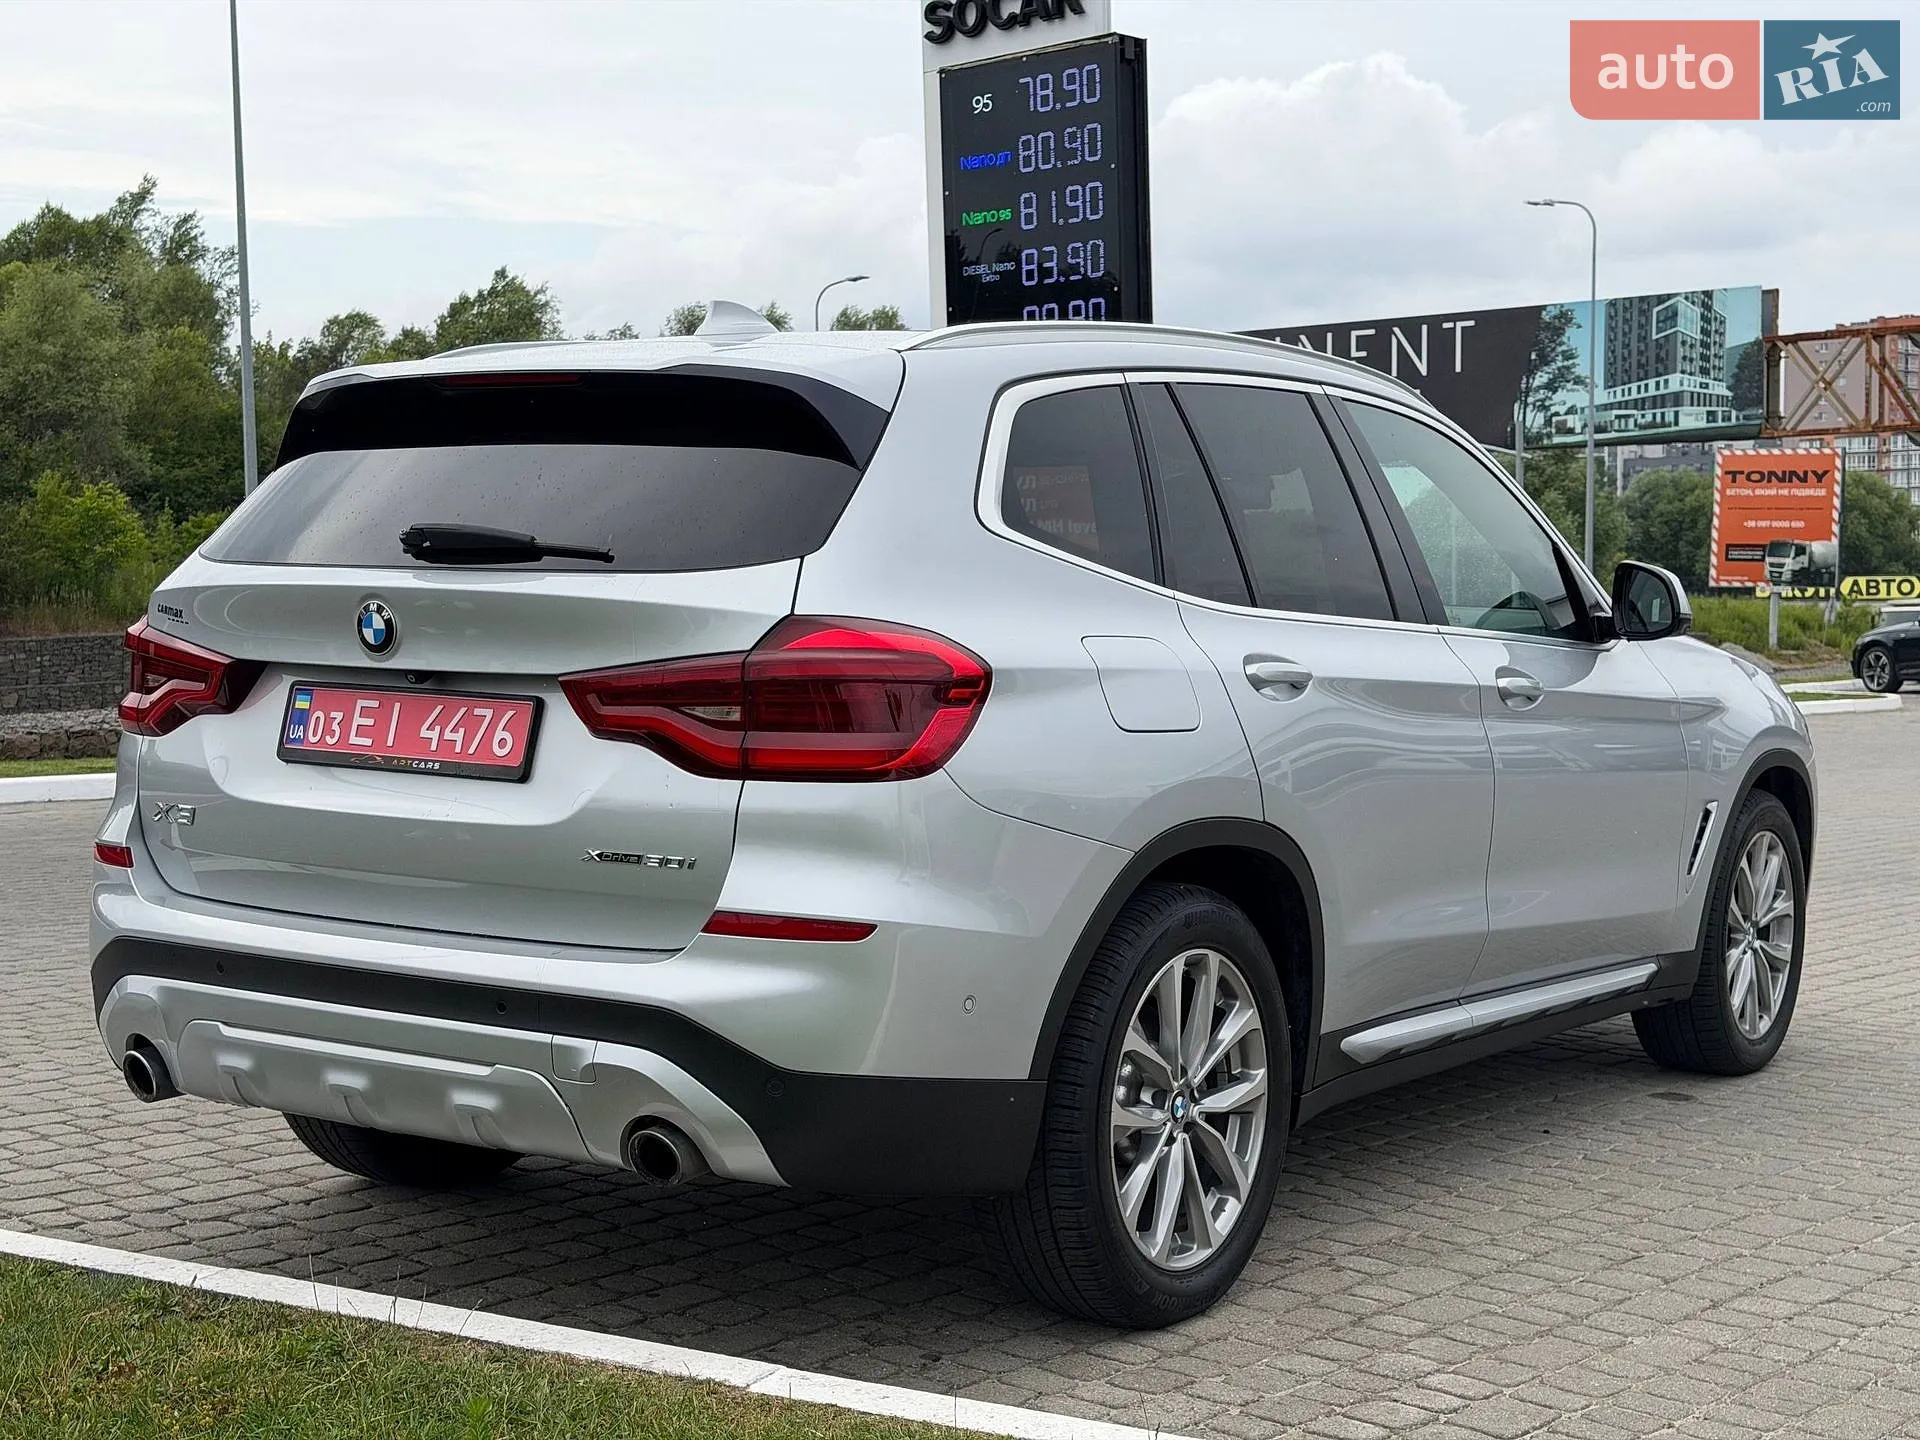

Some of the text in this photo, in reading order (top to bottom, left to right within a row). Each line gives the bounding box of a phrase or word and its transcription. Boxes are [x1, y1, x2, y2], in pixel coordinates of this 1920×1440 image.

[972, 64, 1100, 114] 95 78.90
[1018, 123, 1101, 173] 80.90
[1020, 181, 1103, 230] 81.90
[963, 240, 1105, 286] DIESEL Nano 83.90
[1724, 469, 1830, 484] TONNY
[1779, 487, 1790, 497] НЕ
[1847, 578, 1917, 596] АВТО
[289, 724, 304, 739] UA
[419, 704, 516, 757] 4476
[152, 801, 196, 827] X3
